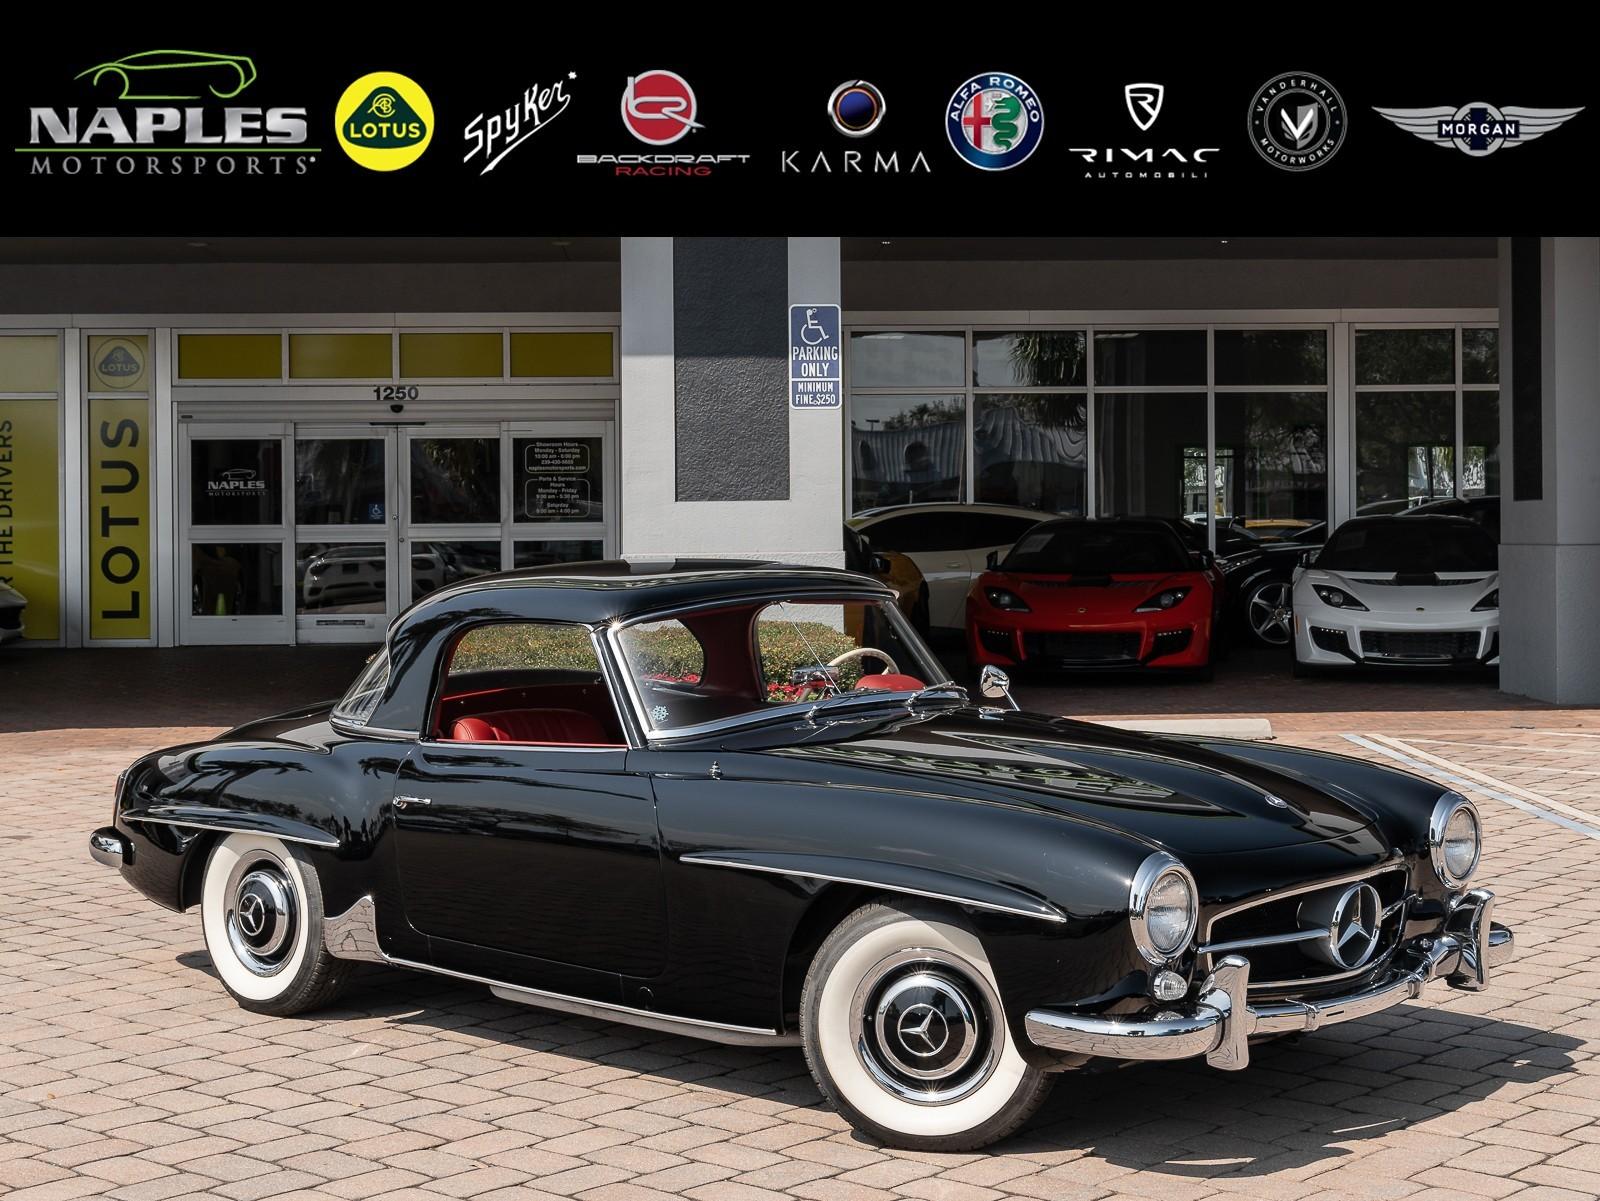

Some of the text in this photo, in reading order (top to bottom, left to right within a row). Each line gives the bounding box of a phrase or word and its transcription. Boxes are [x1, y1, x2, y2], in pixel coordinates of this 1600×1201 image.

[792, 346, 839, 361] PARKING
[102, 363, 139, 372] LOTUS
[801, 362, 830, 377] ONLY
[373, 386, 419, 401] 1250
[797, 382, 834, 393] MINIMUM
[795, 394, 836, 405] FINE $250
[207, 480, 265, 490] NAPLES
[101, 418, 140, 619] LOTUS
